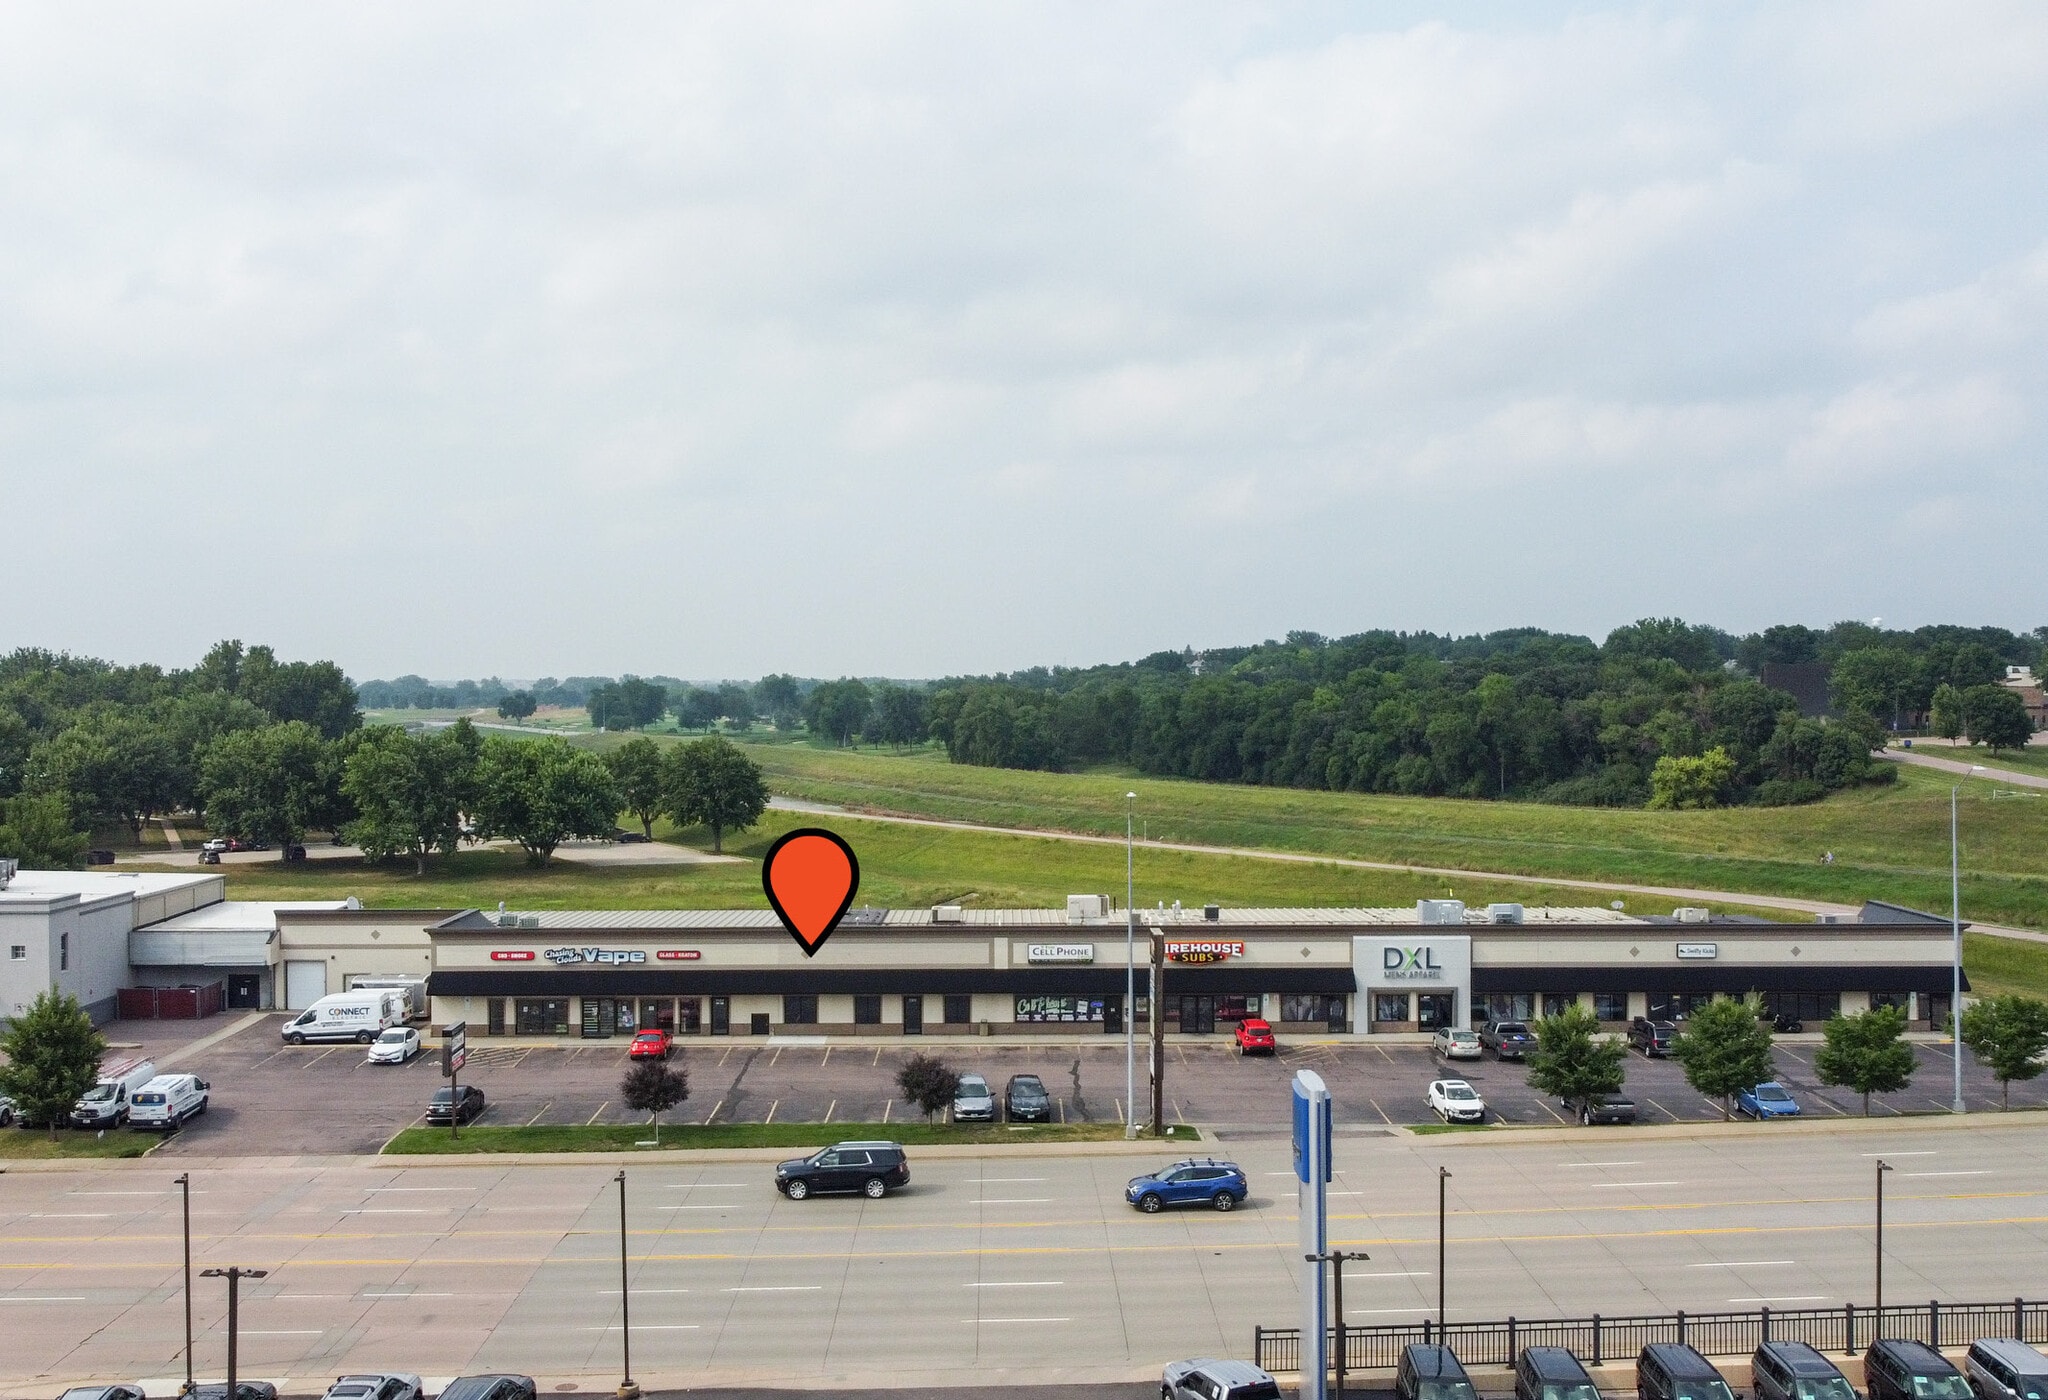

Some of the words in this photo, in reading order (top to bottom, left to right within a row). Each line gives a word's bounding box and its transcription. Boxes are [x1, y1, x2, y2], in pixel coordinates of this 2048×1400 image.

[545, 948, 574, 959] Chasing
[1164, 943, 1242, 957] IREHOUSE
[556, 954, 582, 964] Clouds
[582, 948, 645, 965] Vape
[1182, 953, 1214, 962] SUBS
[1384, 947, 1441, 970] DXL
[1409, 971, 1440, 979] APPAREL
[328, 1007, 370, 1016] CONNECT
